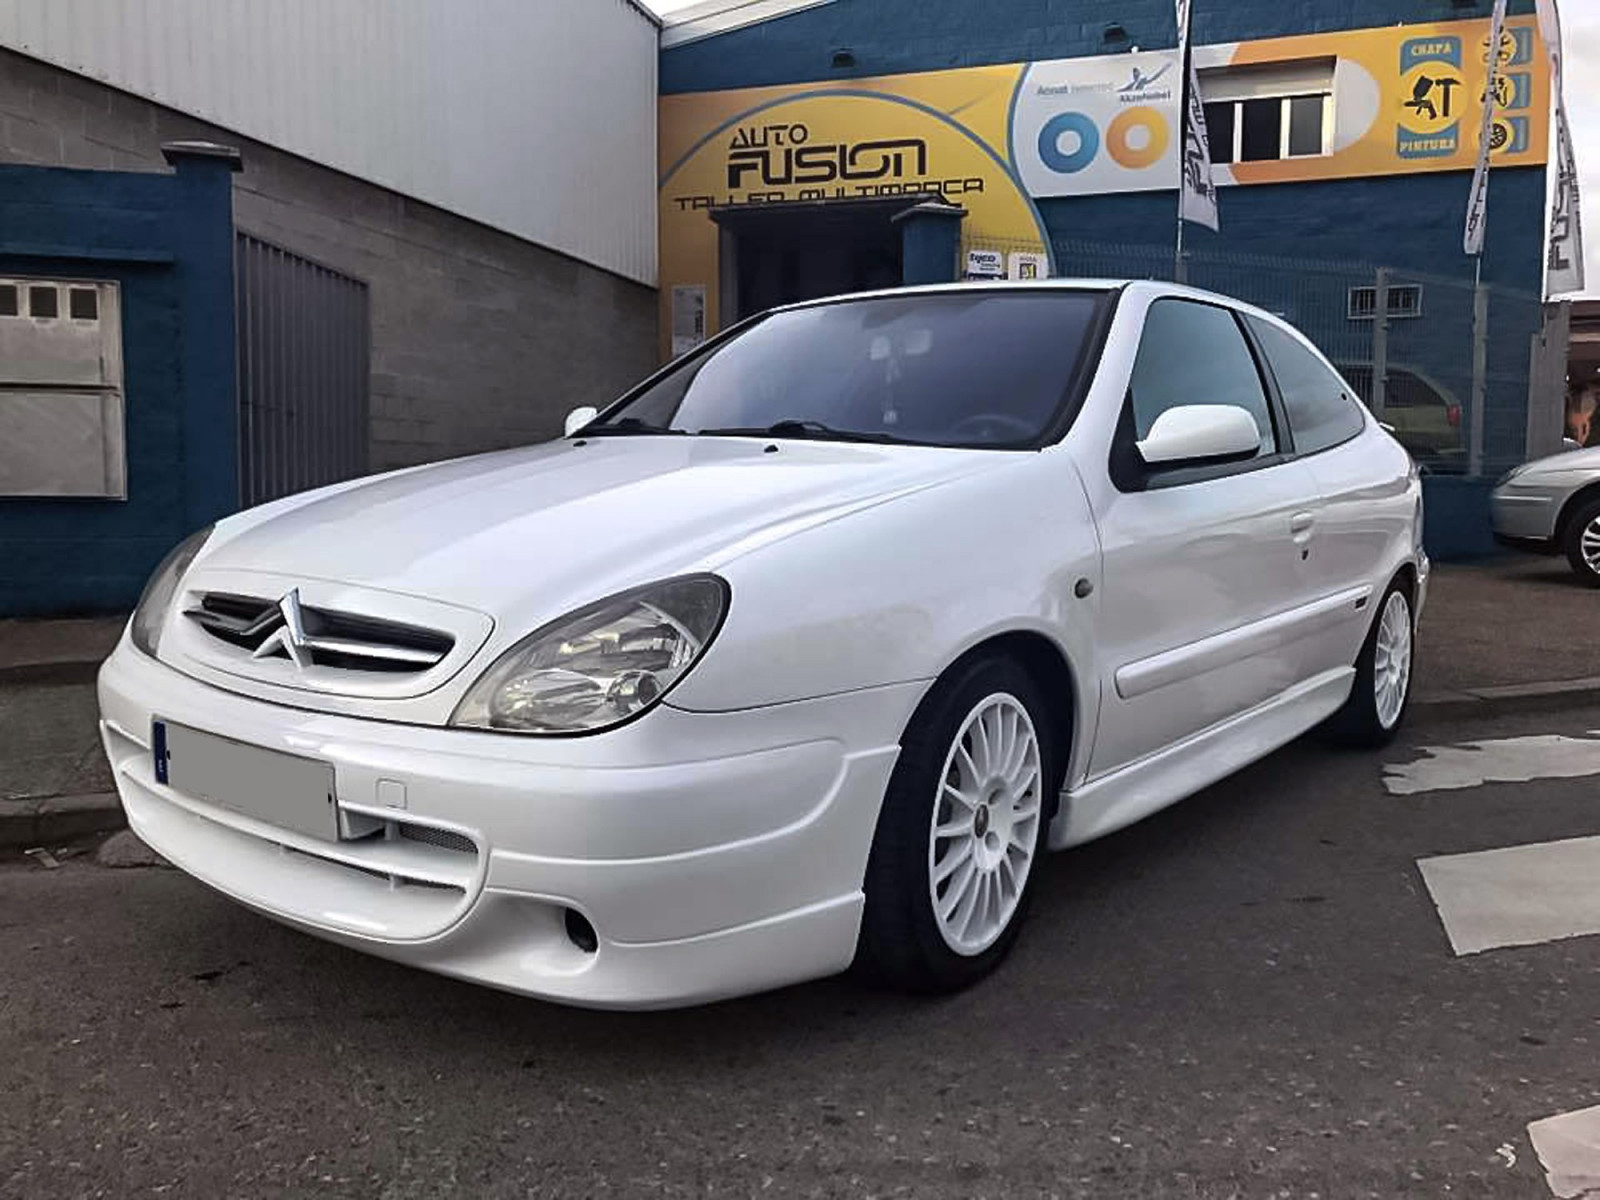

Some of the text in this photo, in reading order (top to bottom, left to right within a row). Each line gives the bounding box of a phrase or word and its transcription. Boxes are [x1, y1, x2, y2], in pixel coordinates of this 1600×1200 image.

[1411, 42, 1452, 56] CHAPA
[729, 123, 809, 150] AUTO
[728, 138, 926, 189] FUSION
